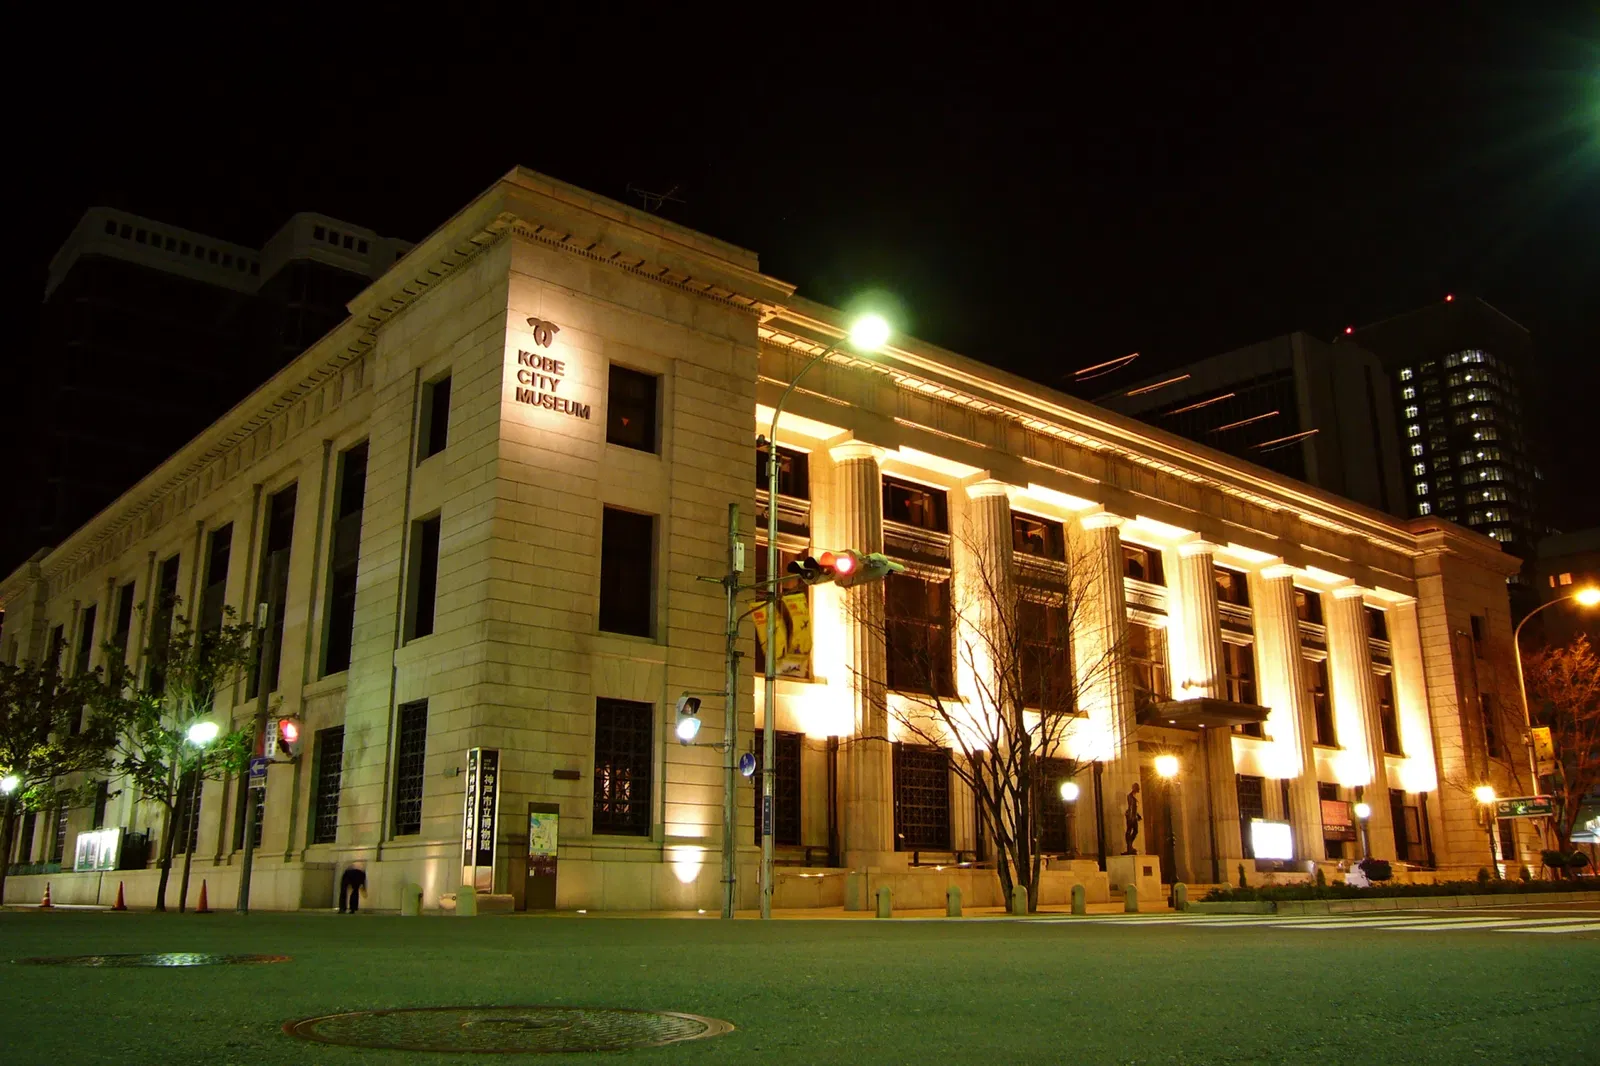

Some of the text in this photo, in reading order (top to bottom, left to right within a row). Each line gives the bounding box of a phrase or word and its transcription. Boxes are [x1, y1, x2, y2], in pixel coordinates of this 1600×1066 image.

[518, 349, 565, 376] KOBE
[517, 369, 560, 392] CITY
[516, 387, 591, 420] MUSEUM
[480, 774, 494, 851] 神戸市立博物館
